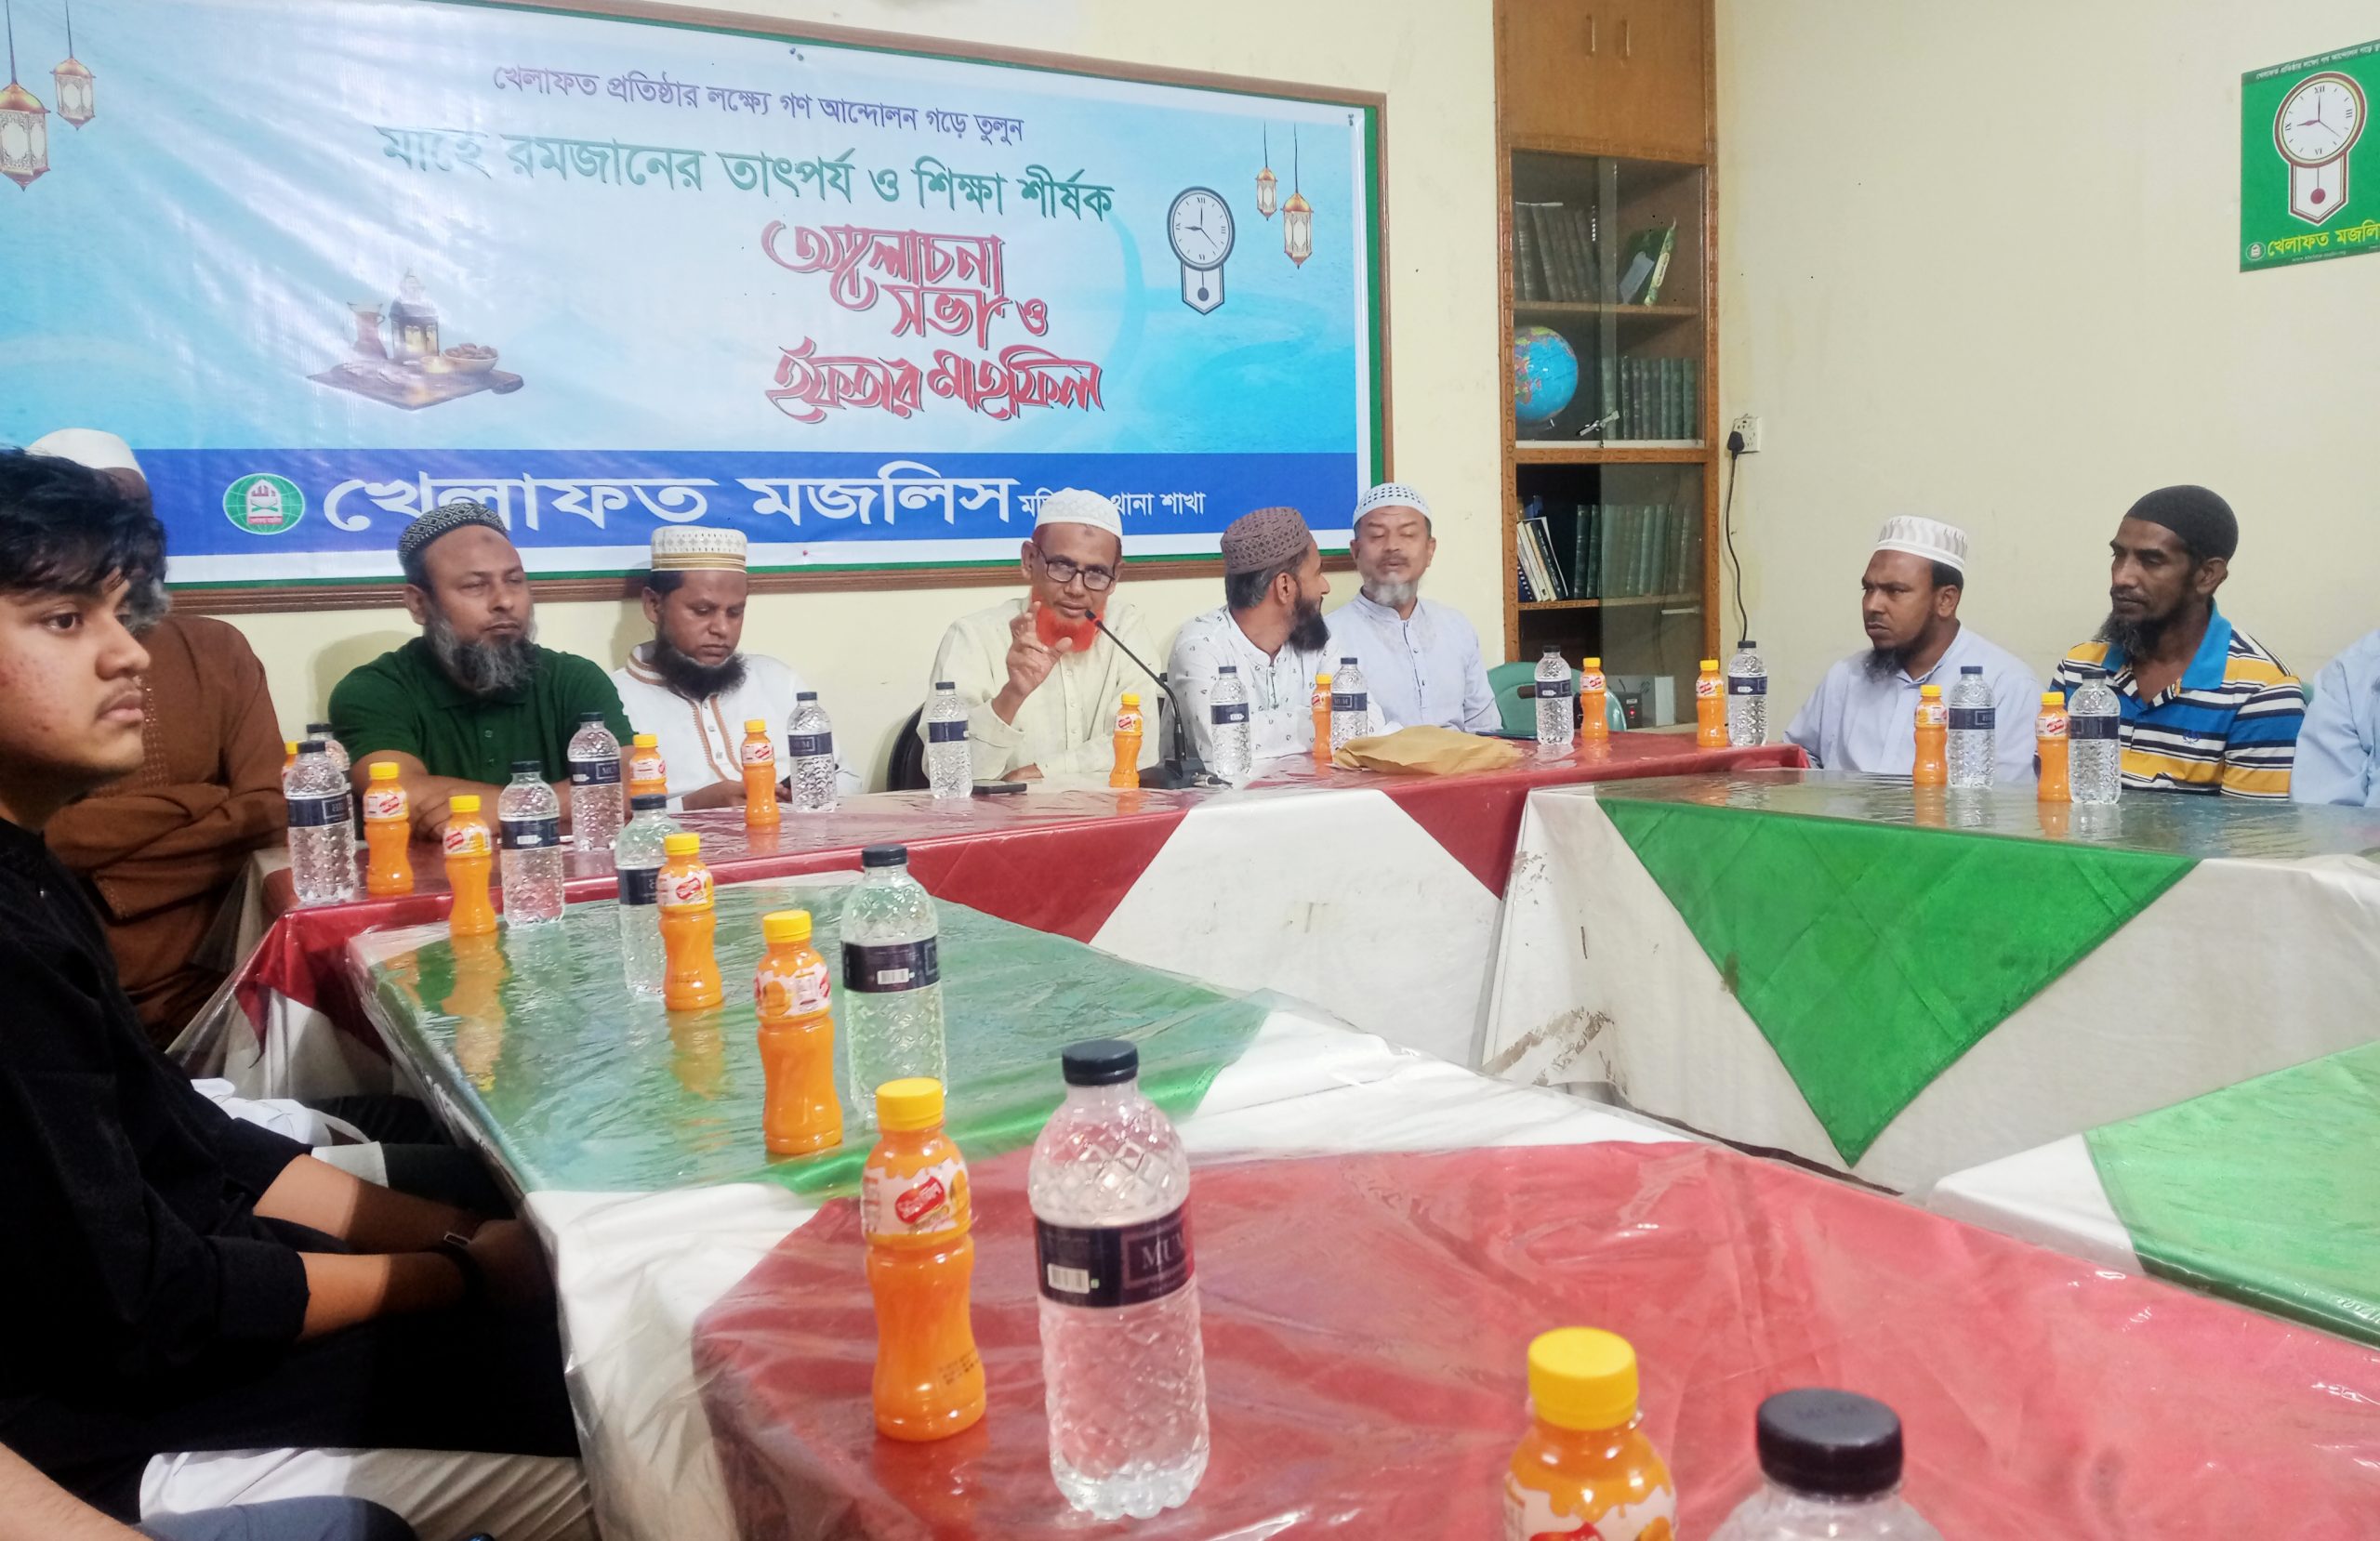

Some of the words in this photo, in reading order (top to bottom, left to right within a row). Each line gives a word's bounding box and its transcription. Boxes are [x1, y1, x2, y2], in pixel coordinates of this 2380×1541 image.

[494, 63, 600, 97] খেলাফত
[607, 70, 699, 109] প্রতিষ্ঠার
[706, 86, 772, 115] লক্ষ্যে
[780, 92, 812, 119] গণ
[818, 98, 919, 131] আন্দোলন
[925, 107, 968, 139] গড়ে
[973, 113, 1025, 147] তুলুন
[374, 125, 492, 179] মাহে
[498, 133, 707, 191] রমজানের
[716, 147, 855, 204] তাৎপর্য
[868, 168, 899, 203] ও
[911, 154, 1009, 216] শিক্ষা
[1016, 164, 1115, 222] শীর্ষক
[760, 219, 1006, 311] আলোচনা
[2268, 231, 2330, 257] খেলাফত
[2334, 219, 2380, 244] মজলি
[879, 283, 1013, 350] সভা
[1014, 297, 1049, 337] ও
[764, 336, 925, 424] ইফতার
[926, 344, 1105, 421] মাহফিল
[323, 470, 719, 532] খেলাফত
[734, 460, 1022, 527] মজলিস
[1159, 491, 1207, 516] শাখা
